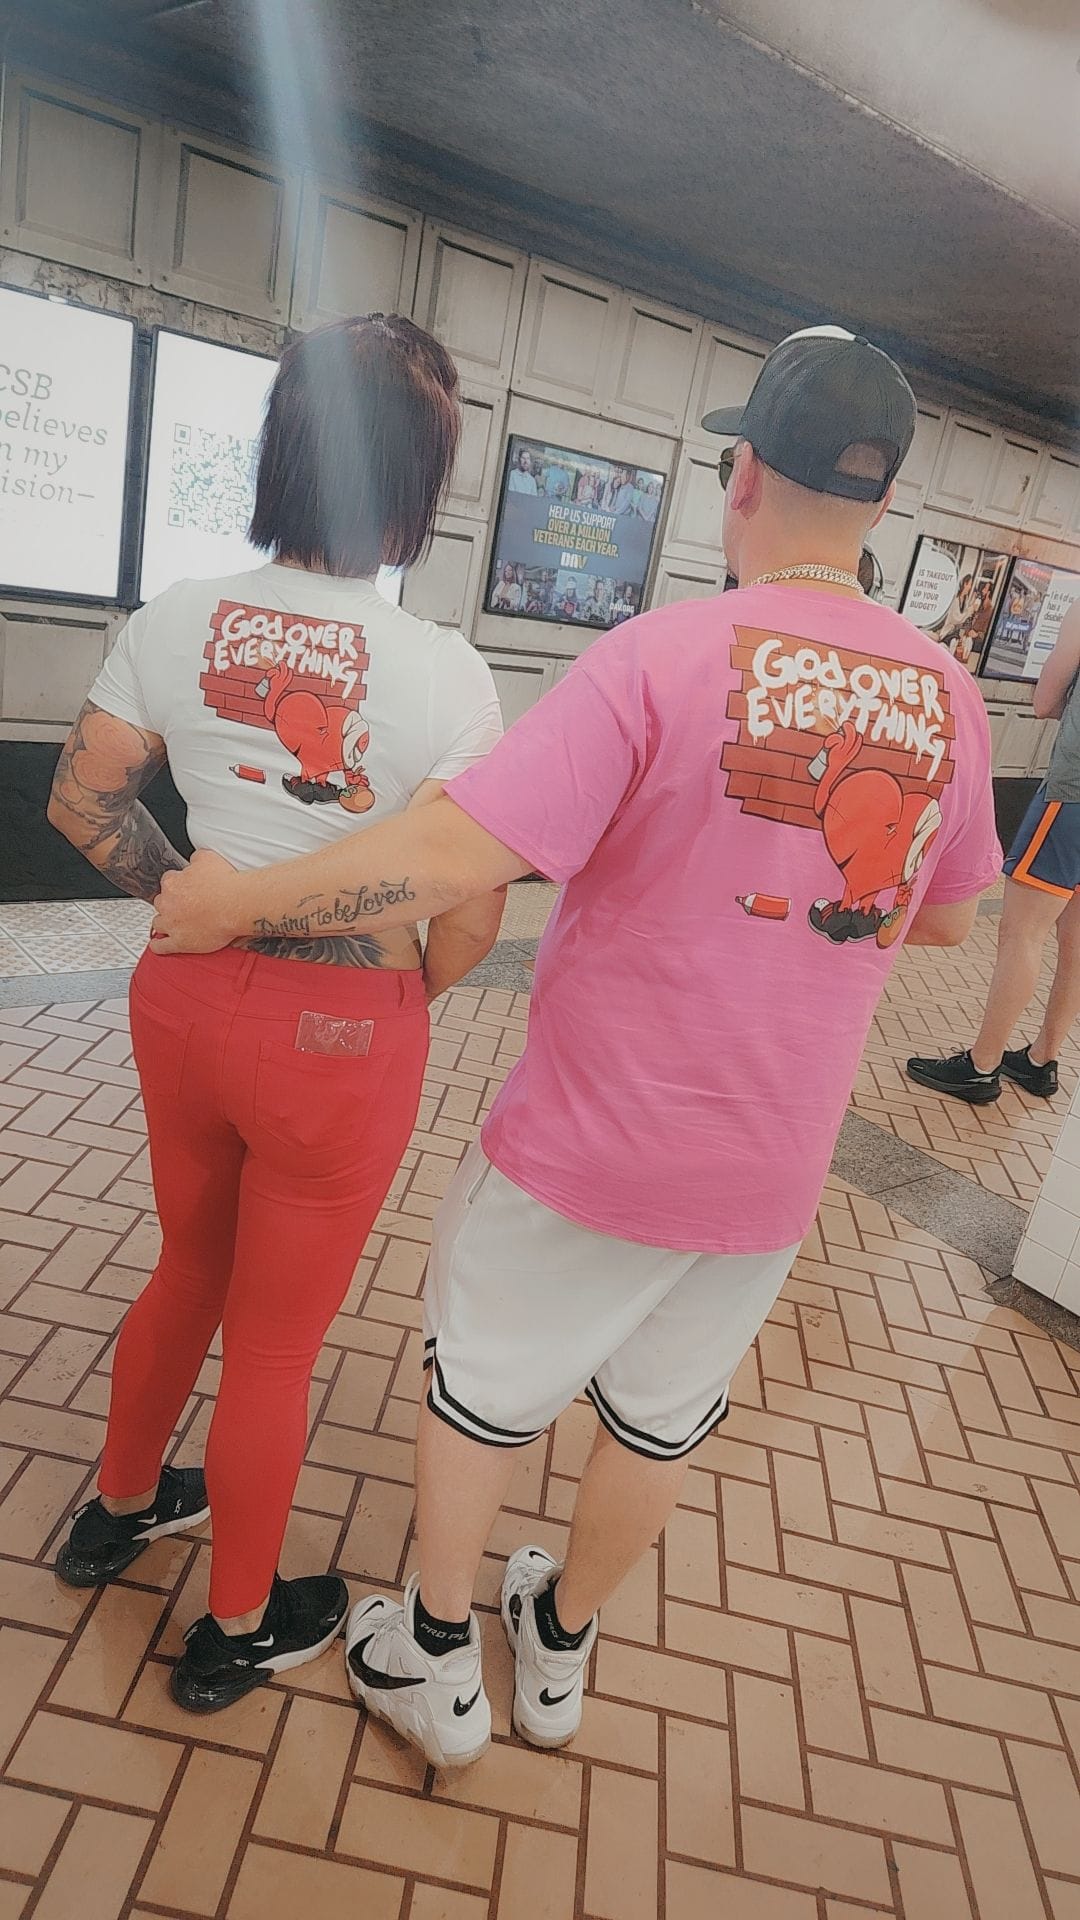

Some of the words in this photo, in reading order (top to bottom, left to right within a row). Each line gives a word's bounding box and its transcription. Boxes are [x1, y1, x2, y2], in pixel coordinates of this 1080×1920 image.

[0, 401, 108, 445] elieves
[24, 446, 67, 476] my
[1, 469, 95, 503] ision—
[548, 519, 569, 534] OVER
[569, 523, 577, 536] A
[577, 524, 610, 542] MILLION
[549, 504, 569, 520] HELP
[570, 509, 581, 523] US
[582, 511, 617, 530] SUPPORT
[534, 528, 575, 548] VETERANS
[575, 537, 596, 552] EACH
[597, 541, 619, 557] YEAR.
[916, 579, 938, 590] EATING
[919, 568, 926, 577] IS
[927, 570, 954, 581] TAKEOUT
[909, 600, 938, 611] BUDGET?
[923, 591, 939, 601] YOUR
[284, 622, 358, 660] OVER
[213, 637, 358, 700] EVERYTHING
[849, 664, 945, 721] OVER
[745, 685, 946, 783] EVERYTHING
[420, 1622, 447, 1638] PRO
